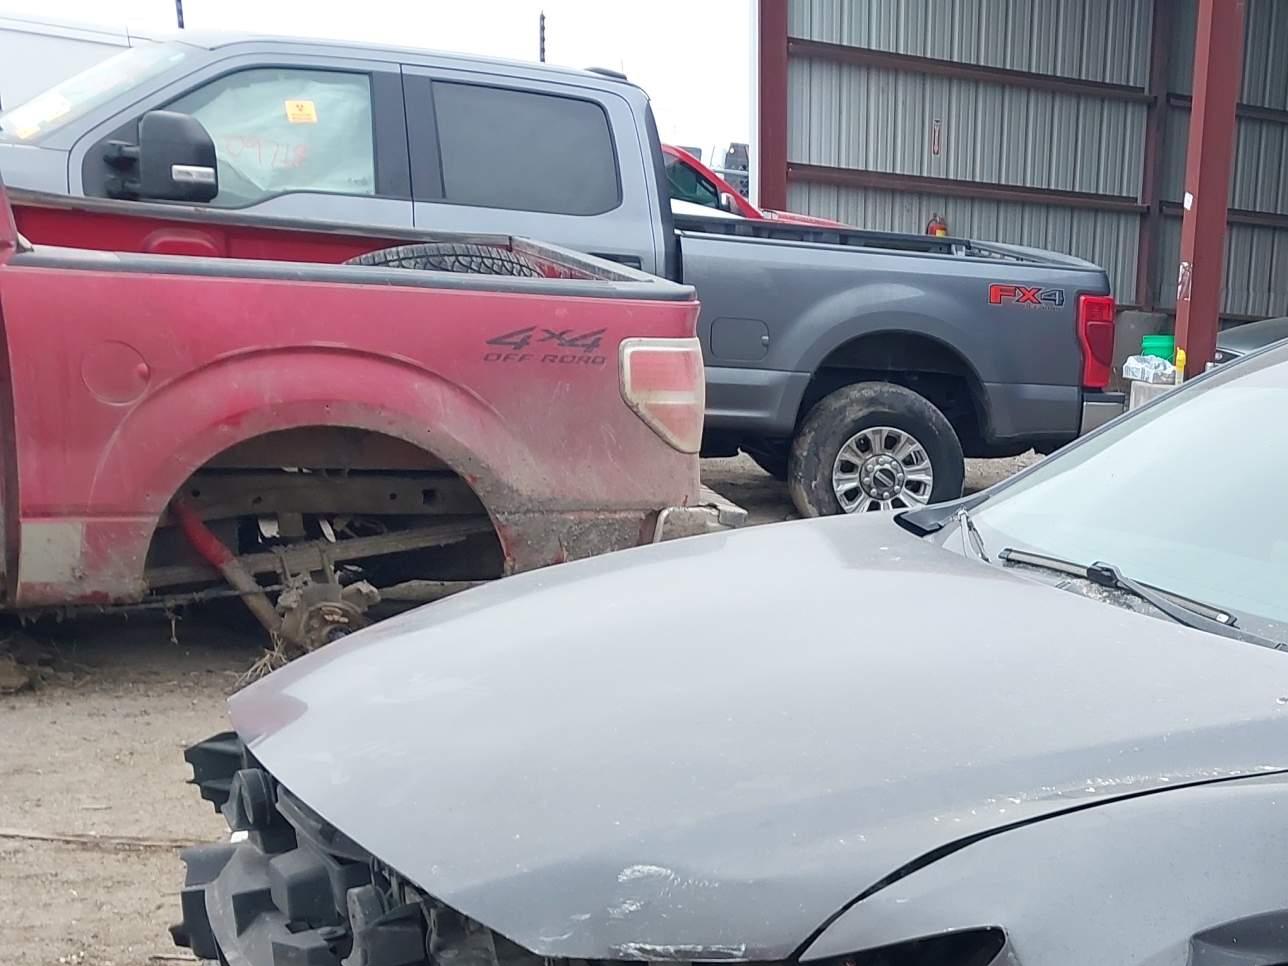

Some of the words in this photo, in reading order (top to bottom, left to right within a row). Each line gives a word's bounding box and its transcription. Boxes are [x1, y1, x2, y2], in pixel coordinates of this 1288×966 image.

[989, 283, 1064, 307] FX4
[484, 352, 534, 362] OFF
[541, 354, 607, 365] ROAD
